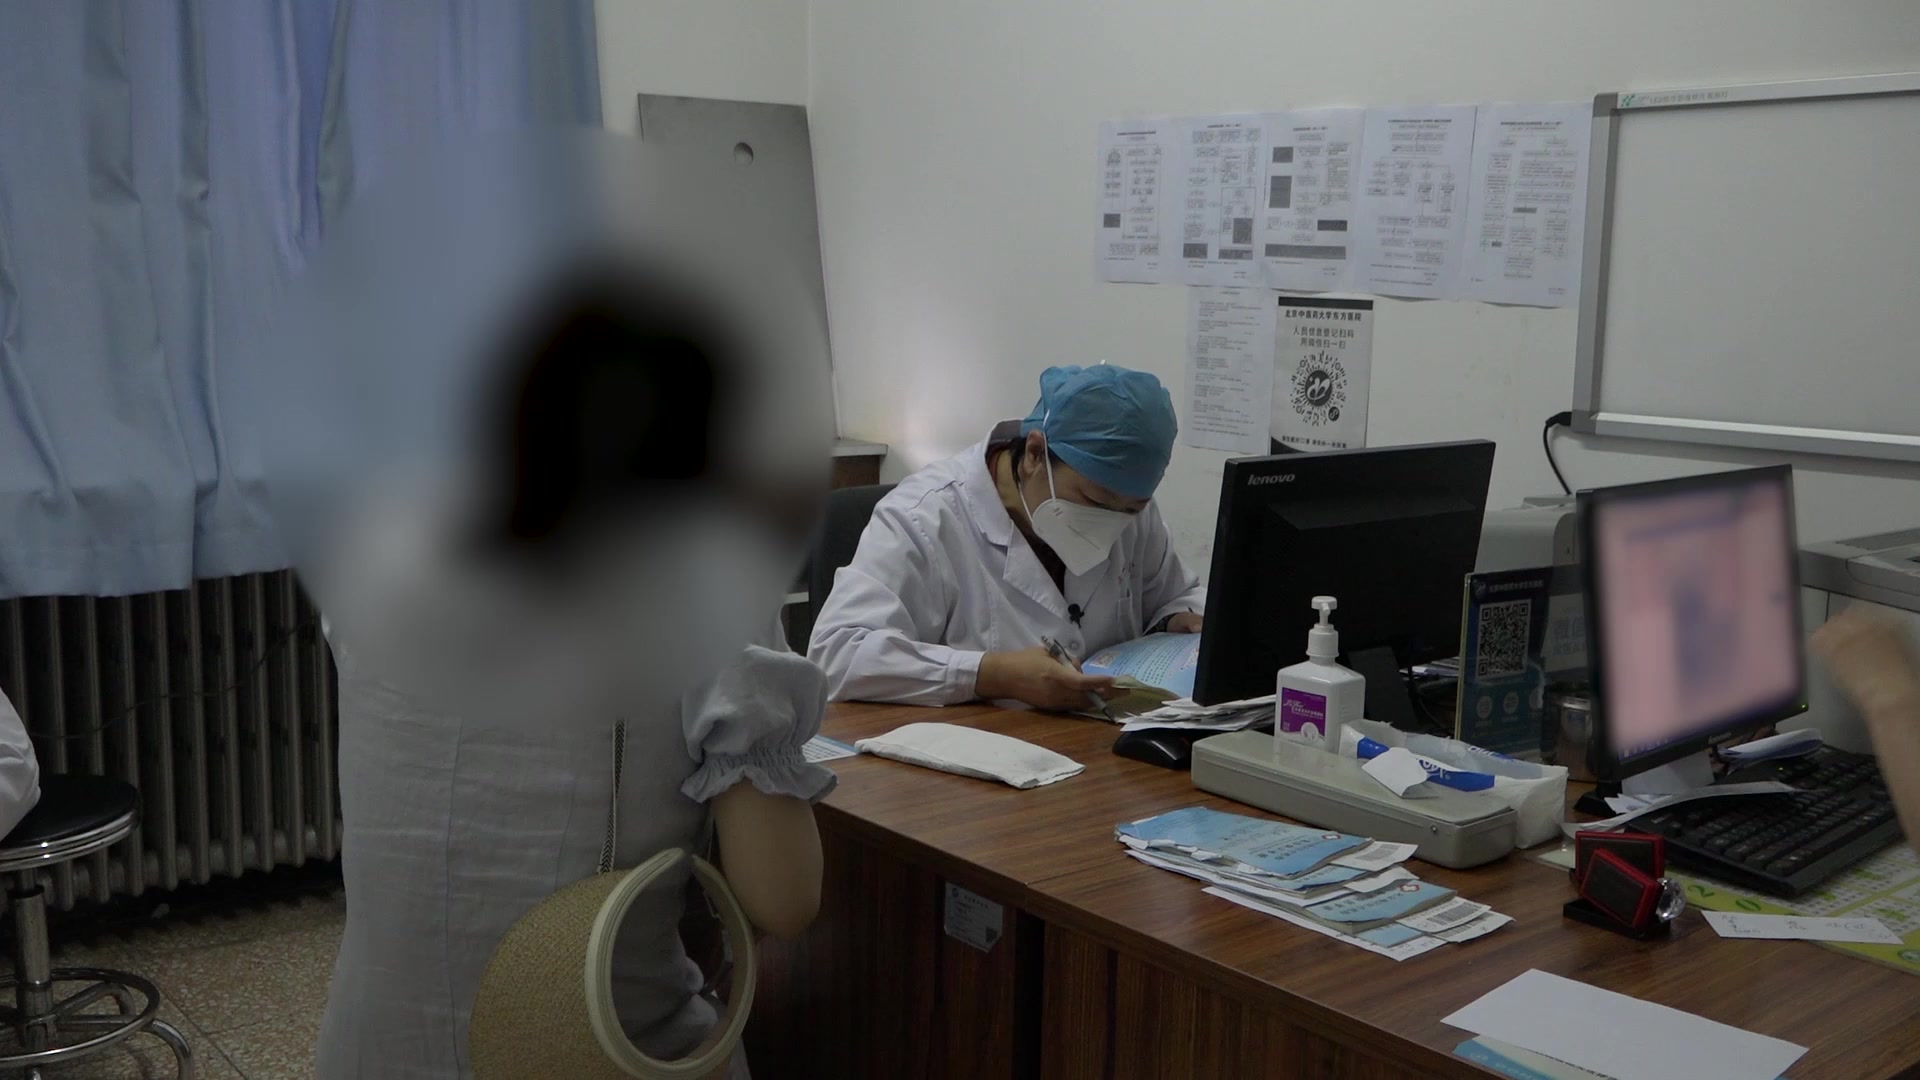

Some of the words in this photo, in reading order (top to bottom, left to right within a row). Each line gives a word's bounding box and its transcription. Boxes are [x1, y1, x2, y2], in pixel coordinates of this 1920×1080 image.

[1285, 309, 1362, 322] 北京中医药大学东方医院
[1293, 326, 1355, 338] 人员信息登记扫码
[1300, 337, 1347, 349] 用微信扫一扫
[1247, 473, 1296, 486] lenovo
